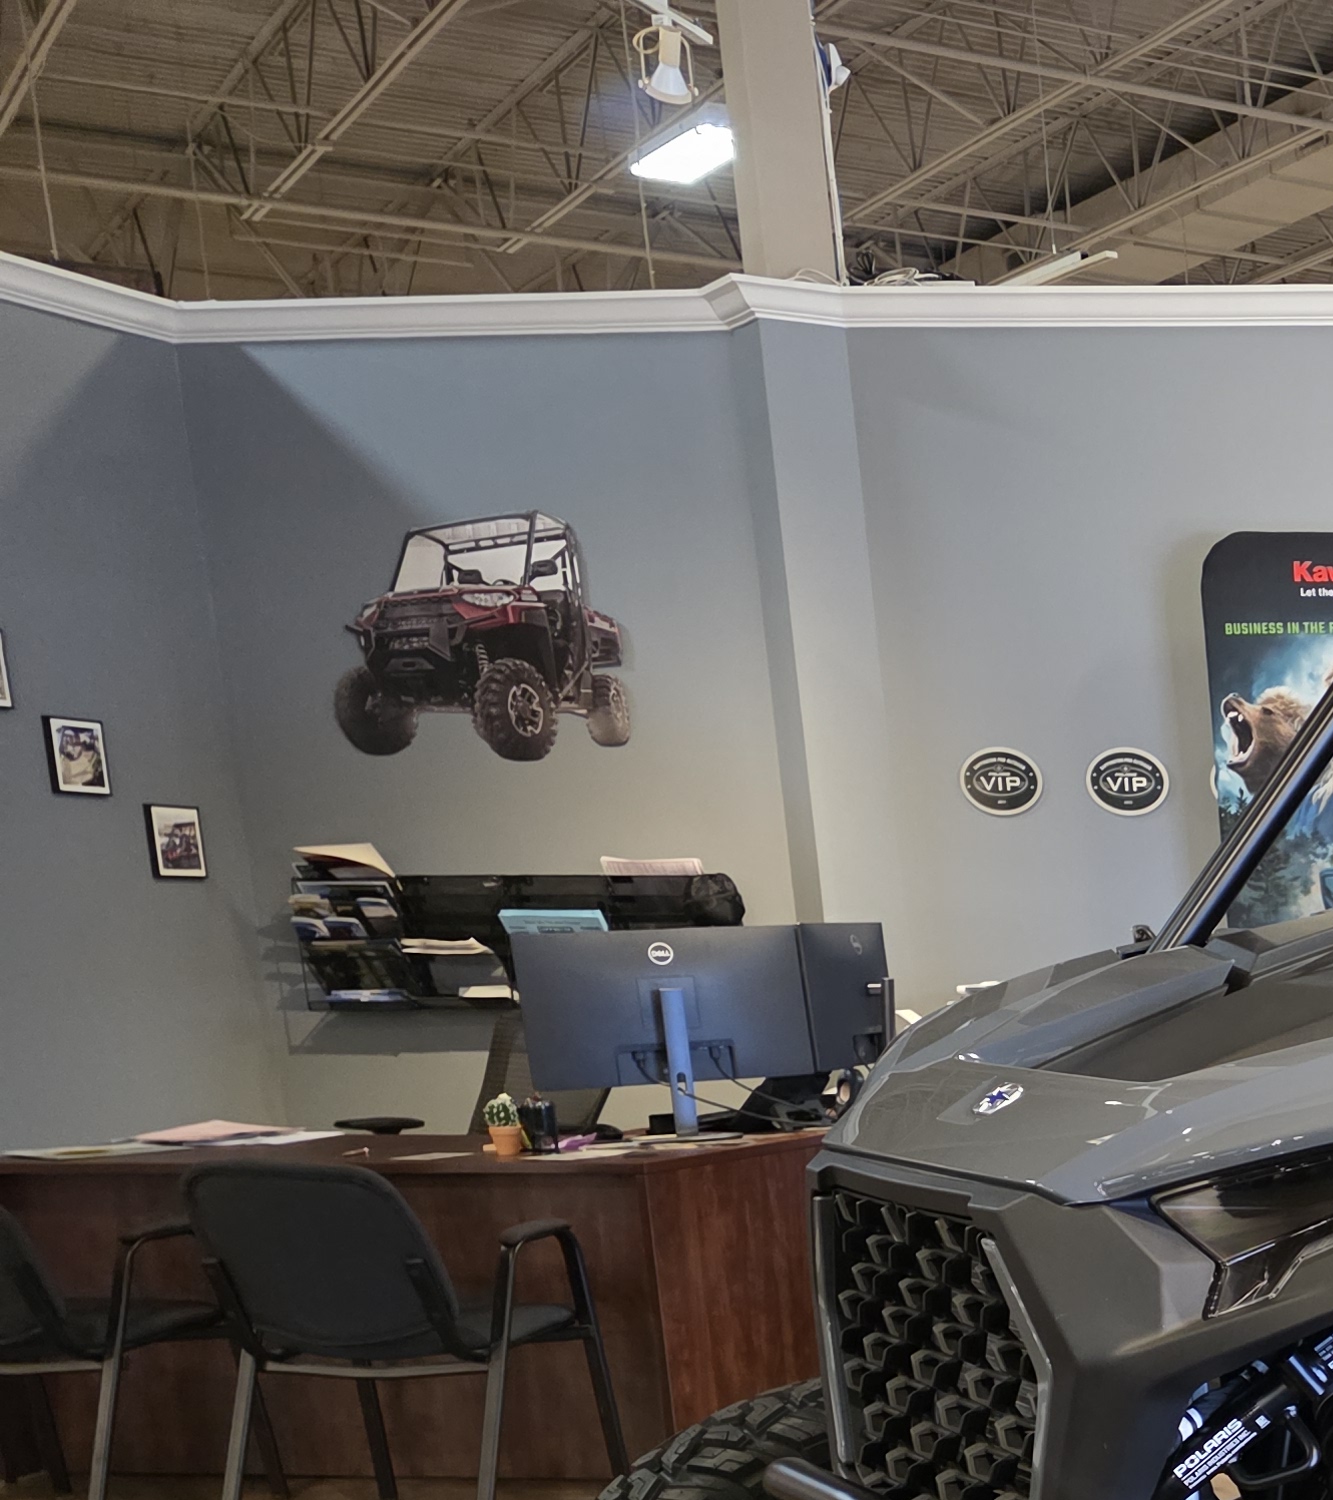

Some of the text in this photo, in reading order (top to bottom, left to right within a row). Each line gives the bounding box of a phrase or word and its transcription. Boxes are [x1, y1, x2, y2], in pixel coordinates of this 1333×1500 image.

[1300, 587, 1316, 597] Let
[1318, 587, 1333, 597] the
[1225, 622, 1284, 635] BUSINESS
[1287, 622, 1299, 634] IN
[1302, 622, 1326, 634] THE
[980, 776, 1021, 792] VIP
[1106, 776, 1148, 792] VIP
[1172, 1418, 1243, 1479] POLARIS
